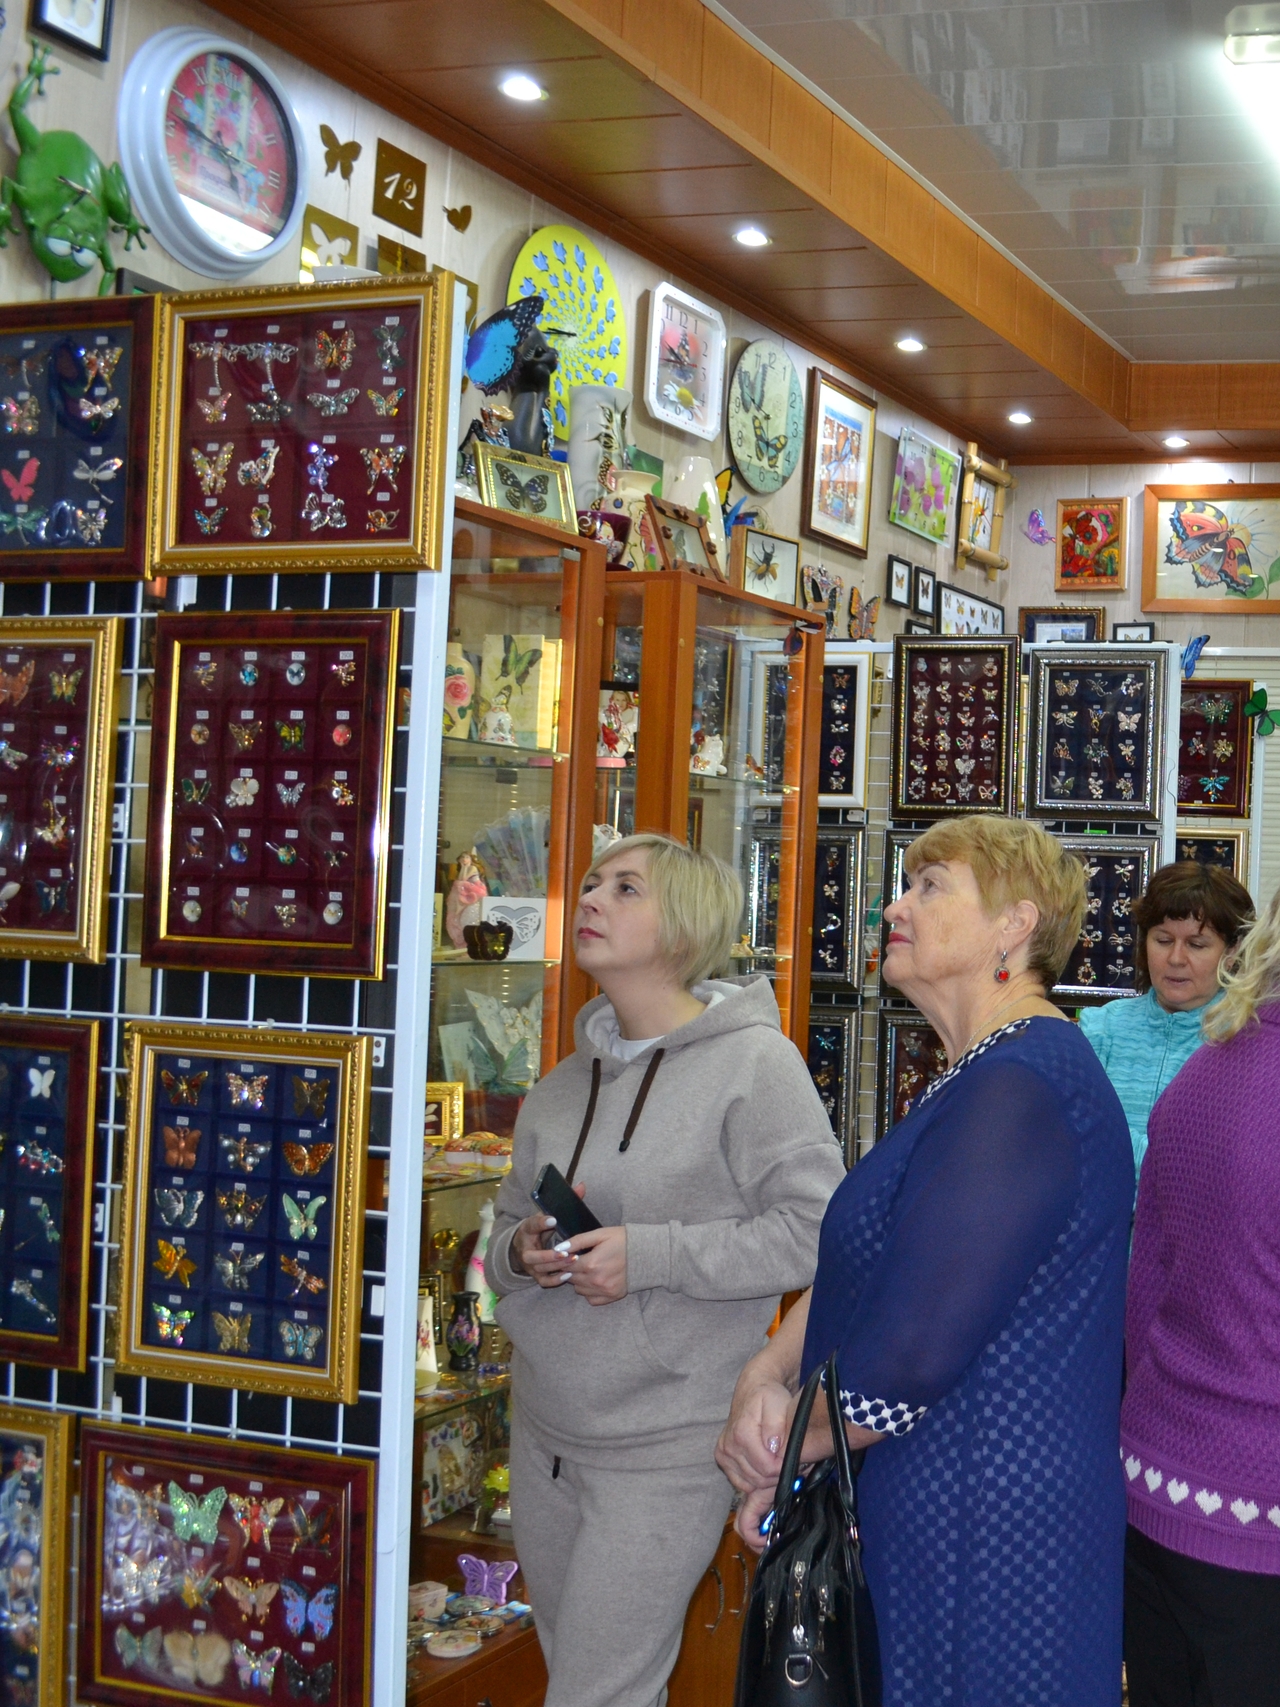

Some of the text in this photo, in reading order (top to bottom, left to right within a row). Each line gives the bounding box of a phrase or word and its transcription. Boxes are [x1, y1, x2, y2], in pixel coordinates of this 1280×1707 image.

[264, 132, 277, 146] II
[268, 169, 281, 190] III
[384, 172, 418, 211] 12
[666, 304, 673, 321] 11
[679, 311, 688, 329] 12
[694, 320, 698, 335] 1
[702, 340, 708, 357] 2
[755, 353, 761, 369] 11
[768, 352, 777, 370] 12
[699, 367, 707, 382] 3
[783, 366, 787, 381] 1
[735, 396, 741, 413] 9
[789, 392, 797, 409] 2
[675, 403, 681, 416] 6
[792, 422, 799, 438] 3
[736, 431, 743, 448] 8
[784, 451, 791, 464] 4
[921, 444, 927, 454] 11
[746, 454, 753, 472] 7
[758, 467, 765, 482] 6
[773, 465, 780, 482] 5
